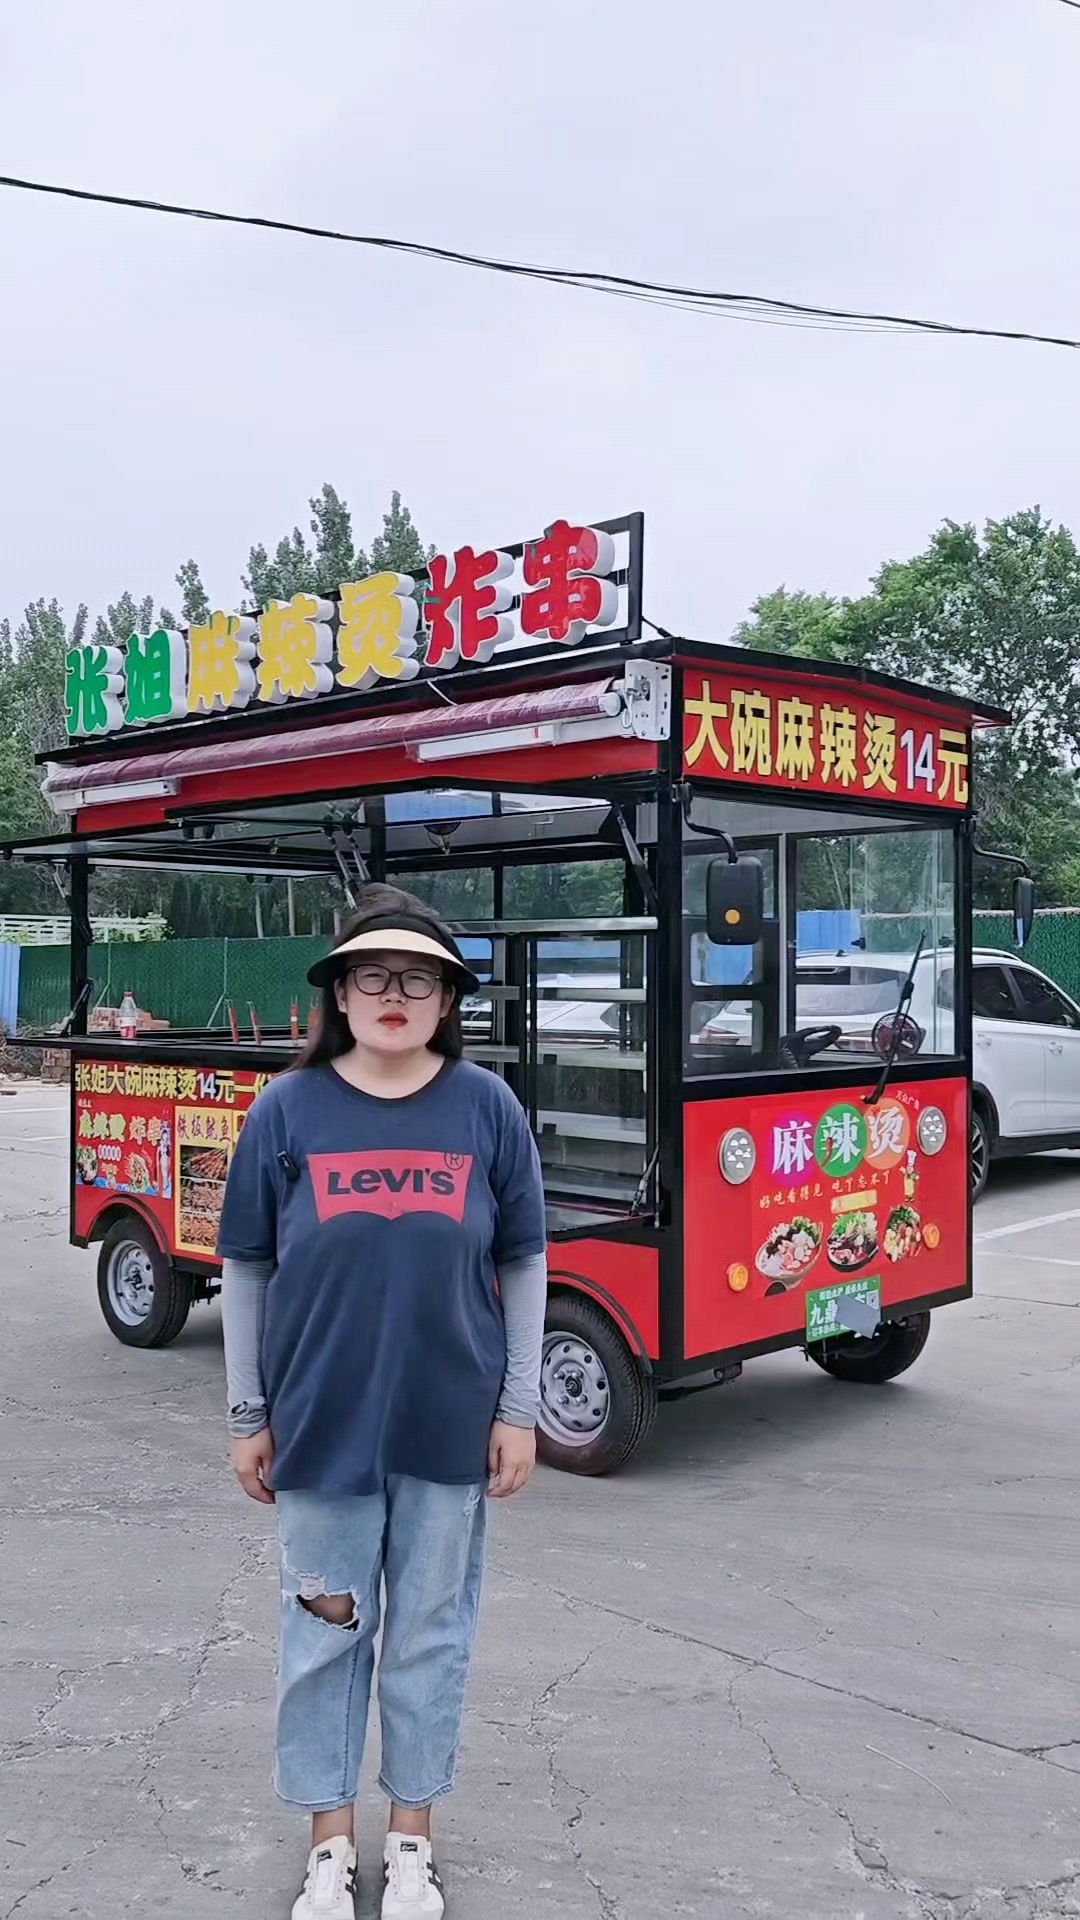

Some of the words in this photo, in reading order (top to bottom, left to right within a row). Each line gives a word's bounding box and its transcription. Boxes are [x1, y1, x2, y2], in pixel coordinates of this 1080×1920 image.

[684, 680, 969, 804] 大碗麻辣烫14元
[771, 1107, 905, 1175] 麻辣烫
